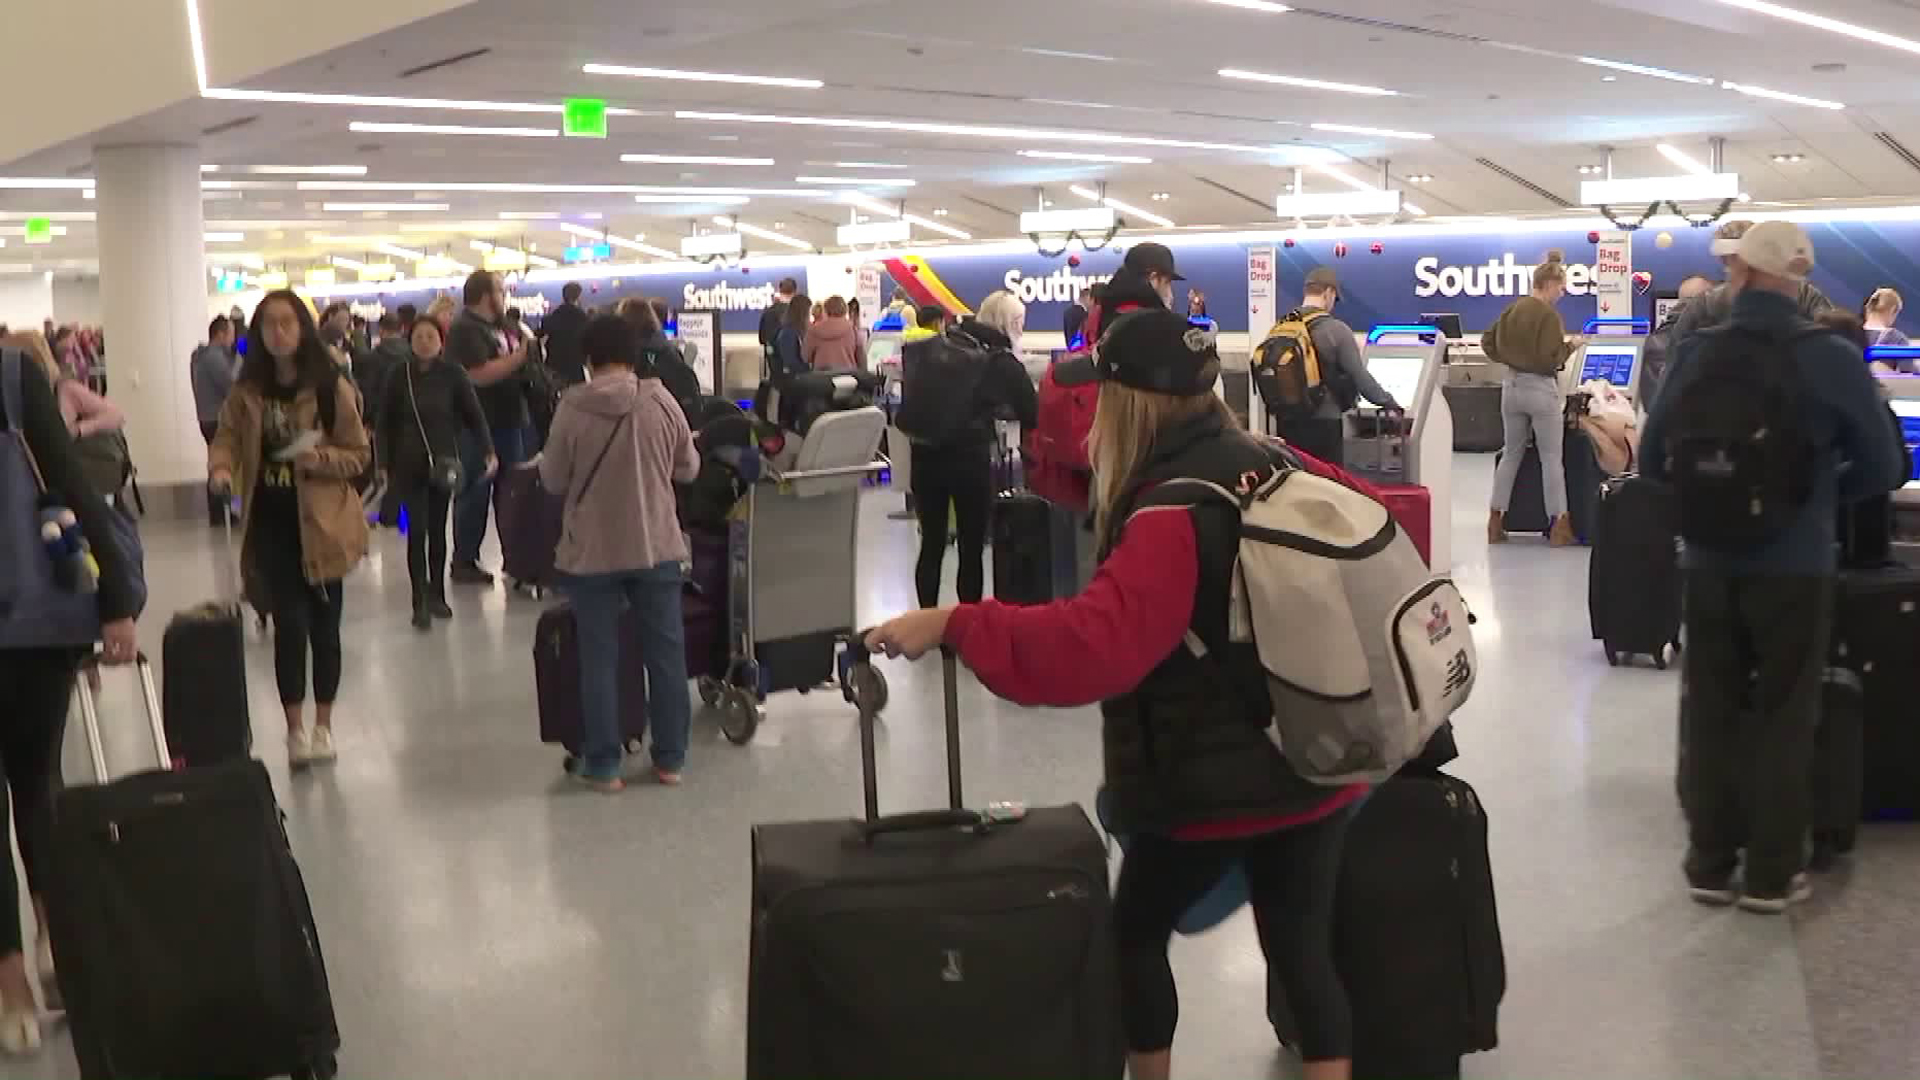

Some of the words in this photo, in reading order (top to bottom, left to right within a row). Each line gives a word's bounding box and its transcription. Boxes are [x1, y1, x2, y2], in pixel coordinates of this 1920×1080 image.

[1599, 248, 1621, 262] Bag
[1250, 271, 1272, 283] Drop
[1600, 263, 1627, 277] Drop
[683, 279, 776, 311] Southwest
